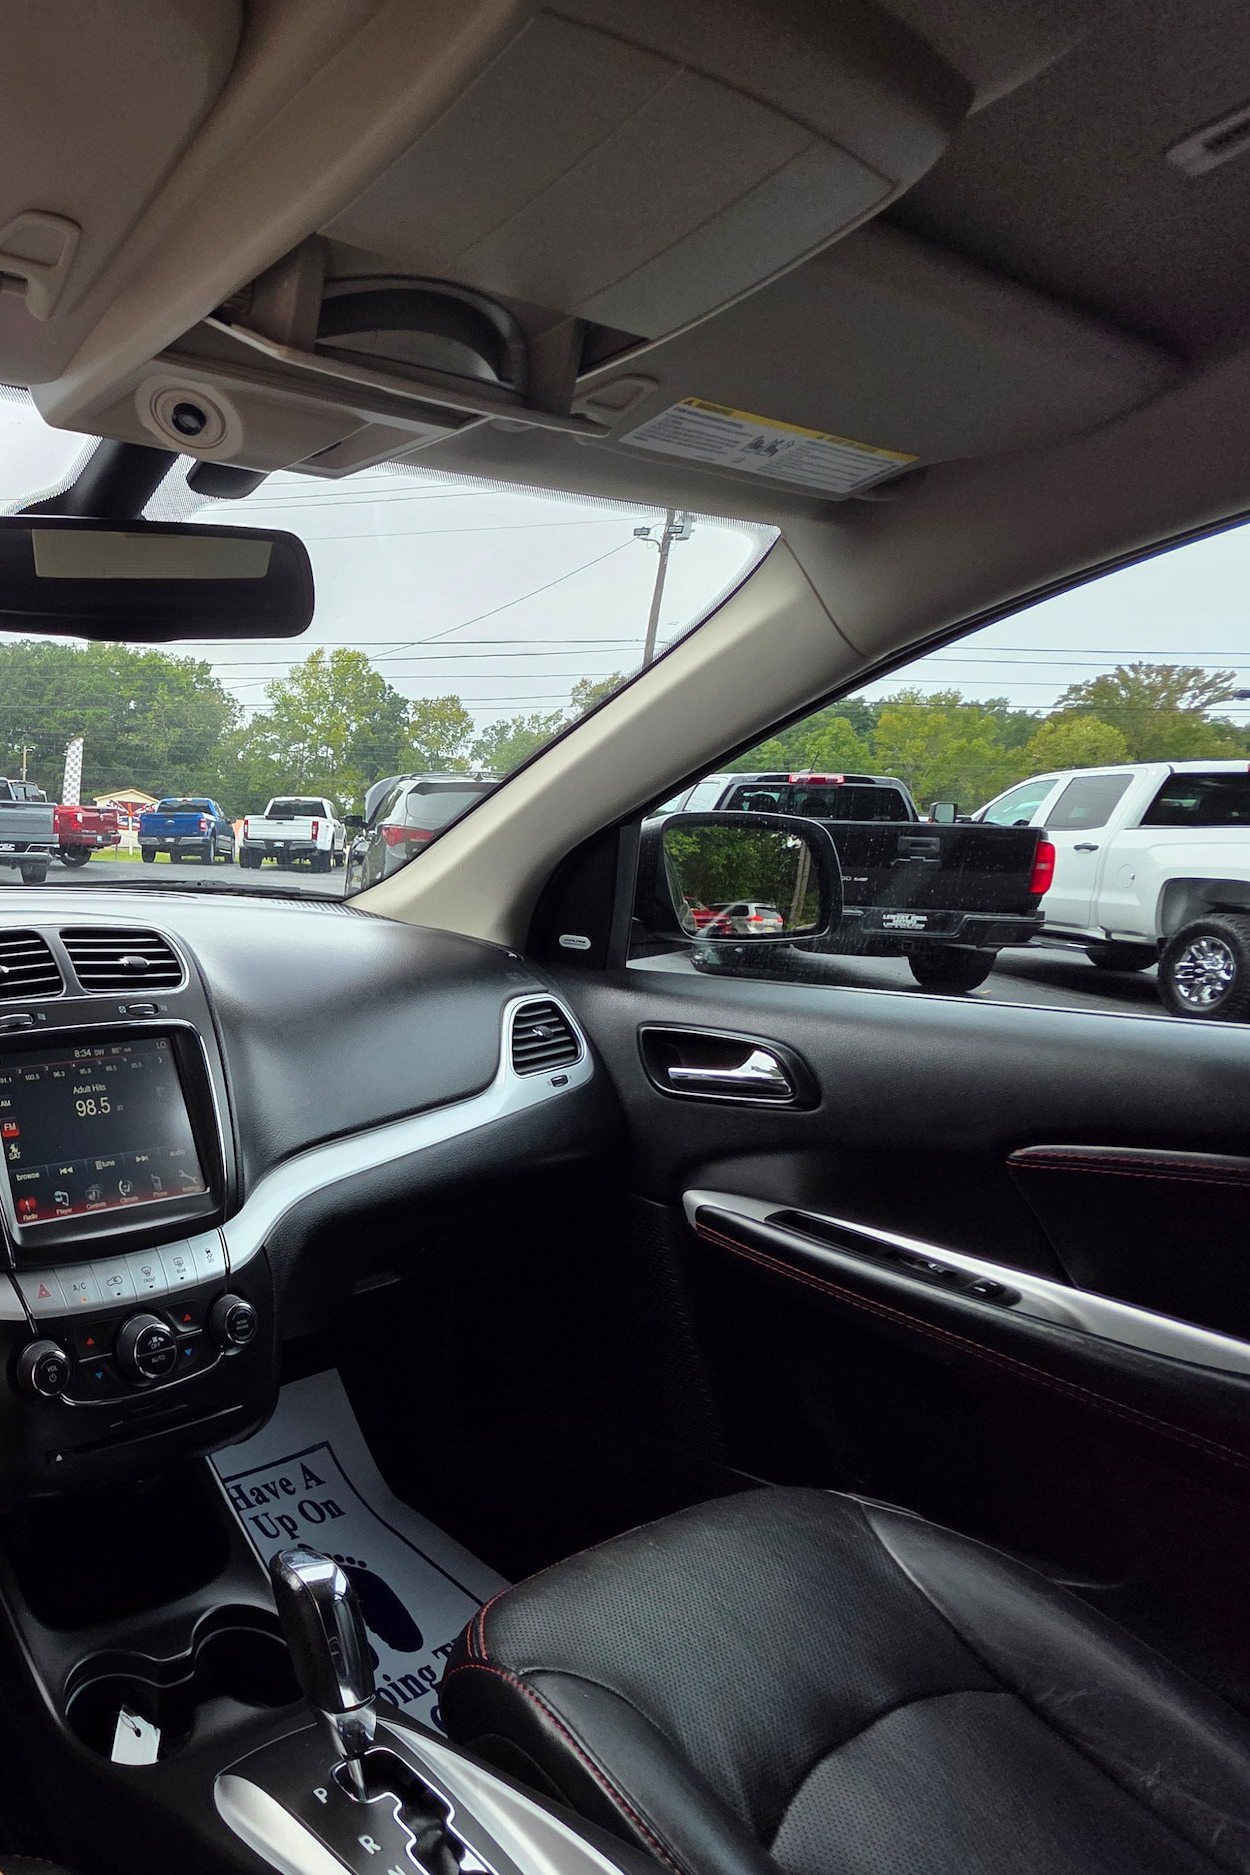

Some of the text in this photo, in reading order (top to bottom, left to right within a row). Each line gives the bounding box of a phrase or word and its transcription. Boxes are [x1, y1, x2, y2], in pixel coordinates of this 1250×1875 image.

[156, 1040, 166, 1049] LO
[74, 1048, 91, 1058] 8:34
[73, 1083, 107, 1094] Adult Hits
[75, 1097, 111, 1117] 98.5
[4, 1123, 17, 1131] FM
[9, 1152, 22, 1160] SAT
[101, 1159, 115, 1168] tune
[16, 1171, 40, 1181] browse
[73, 1282, 87, 1292] A/C
[151, 1354, 166, 1362] AUTO
[226, 1462, 326, 1512] Have A
[248, 1499, 346, 1541] Up On
[312, 1787, 328, 1804] P
[358, 1835, 382, 1855] R
